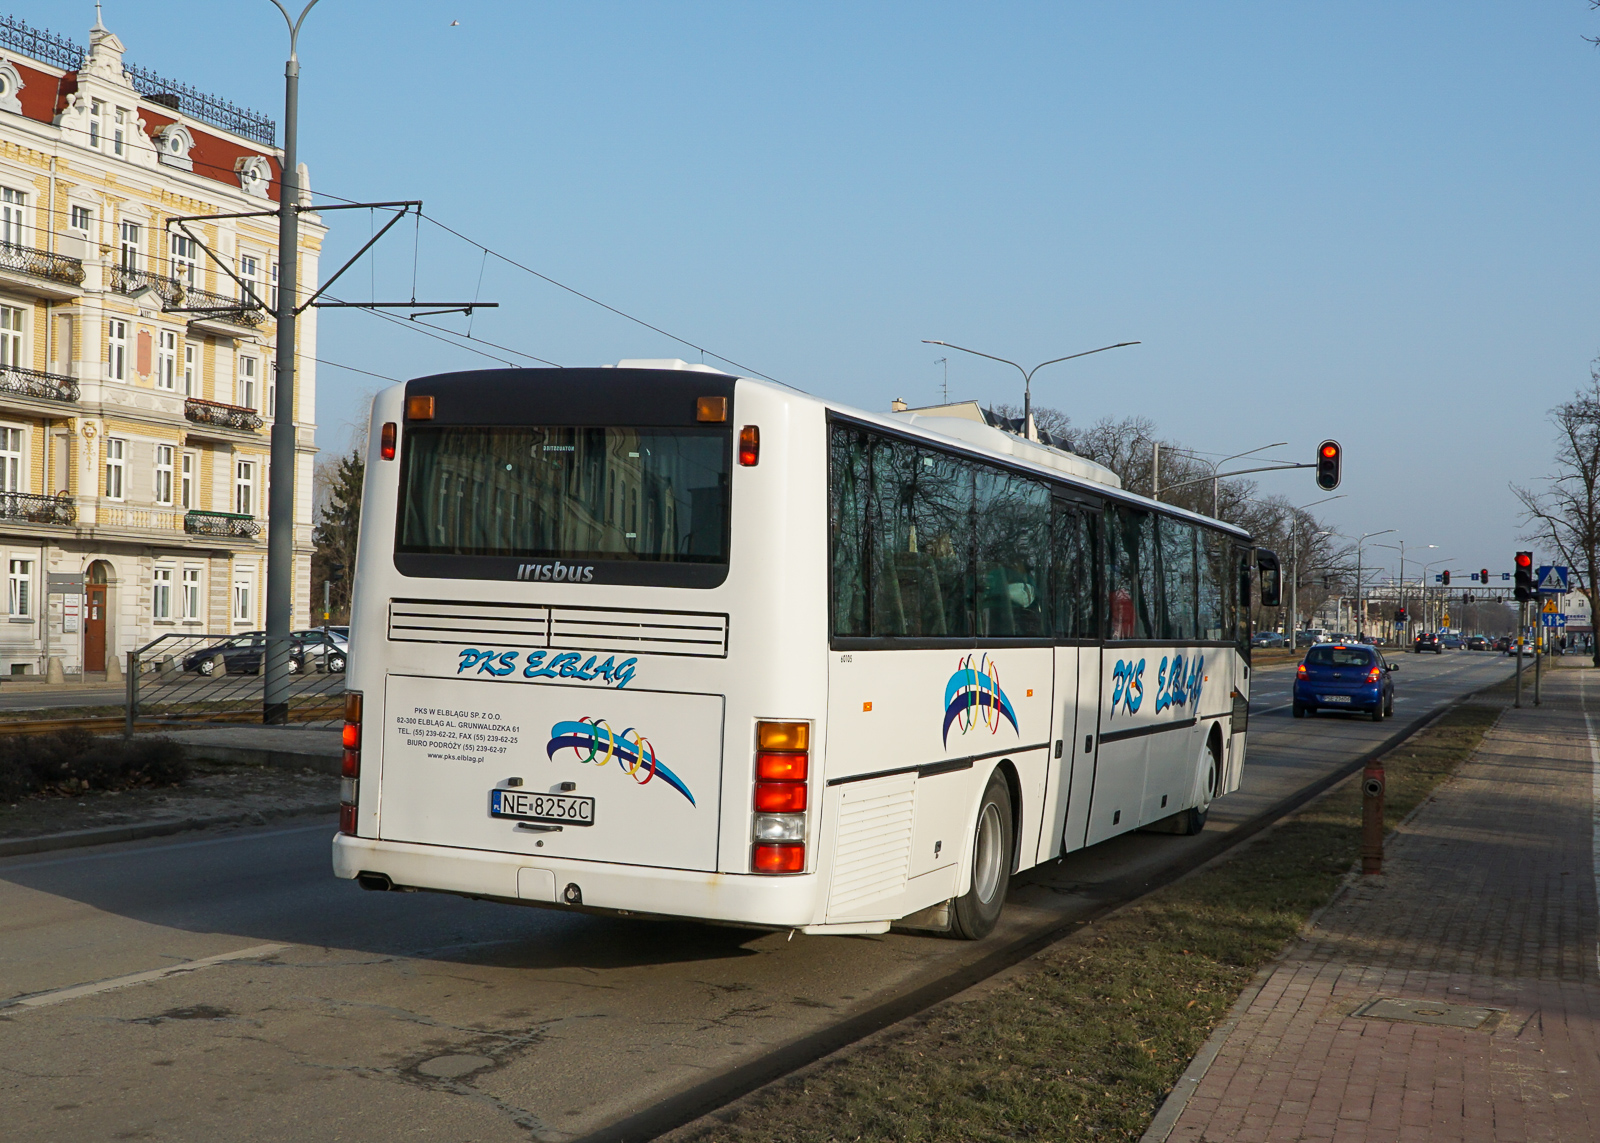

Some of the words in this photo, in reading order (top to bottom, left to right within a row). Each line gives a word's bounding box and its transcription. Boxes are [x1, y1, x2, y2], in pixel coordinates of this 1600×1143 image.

[516, 561, 595, 582] irisbus
[457, 648, 519, 677] PKS
[523, 650, 638, 689] ELBLĄG
[1110, 658, 1146, 721] PKS
[414, 707, 428, 715] PKS
[436, 709, 469, 719] ELBLĄGU
[470, 711, 480, 719] SP.
[396, 717, 417, 725] 82-300
[417, 718, 444, 728] ELBLĄG
[458, 721, 511, 732] GRUNWALDZKA
[398, 727, 411, 735] TEL.
[412, 729, 425, 737] (55)
[425, 730, 458, 739] 239-62-22,
[458, 732, 472, 740] FAX
[473, 734, 486, 742] (55)
[487, 735, 519, 744] 239-62-25
[407, 739, 428, 747] BIURO
[428, 740, 461, 750] PODRÓŻY
[476, 745, 507, 754] 239-62-97
[427, 752, 484, 763] www.pks.elblag.pl
[503, 794, 528, 814] NE
[534, 797, 590, 820] 8256C
